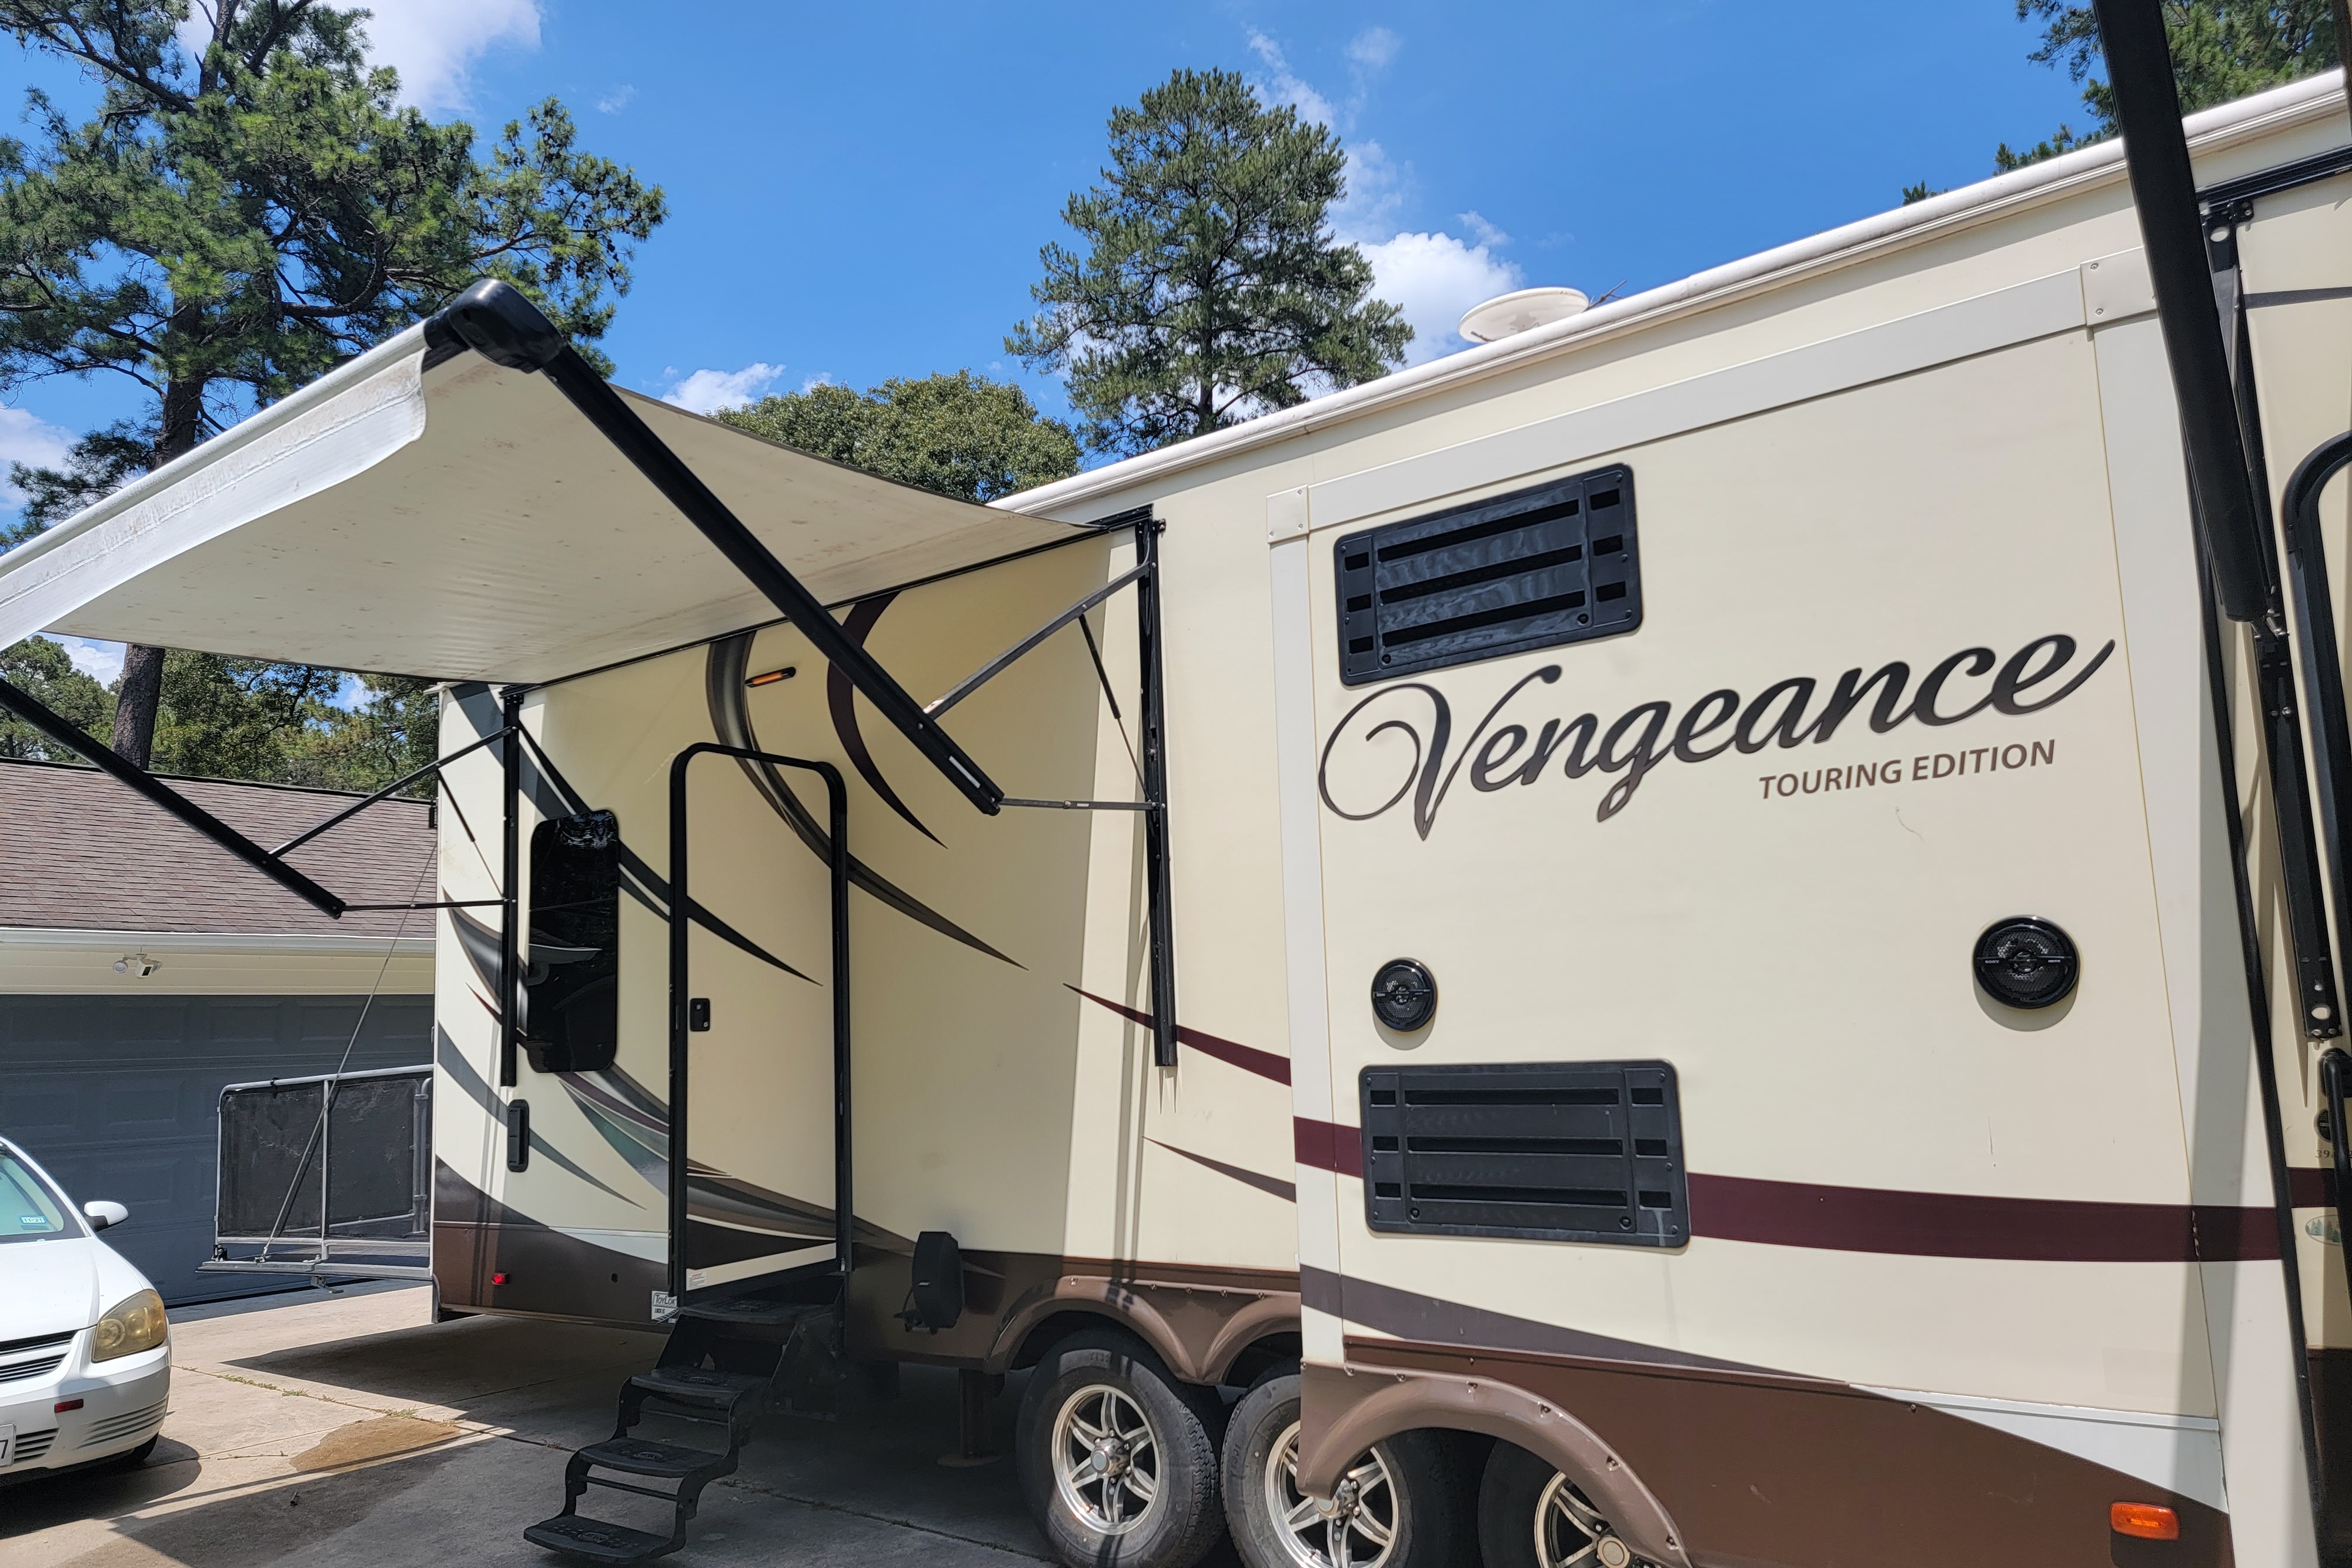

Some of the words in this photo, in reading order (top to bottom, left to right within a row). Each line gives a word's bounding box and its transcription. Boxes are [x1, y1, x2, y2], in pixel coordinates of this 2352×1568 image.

[1318, 634, 2115, 841] Vengeance
[1759, 759, 1902, 800] TOURING
[1912, 738, 2055, 781] EDITION
